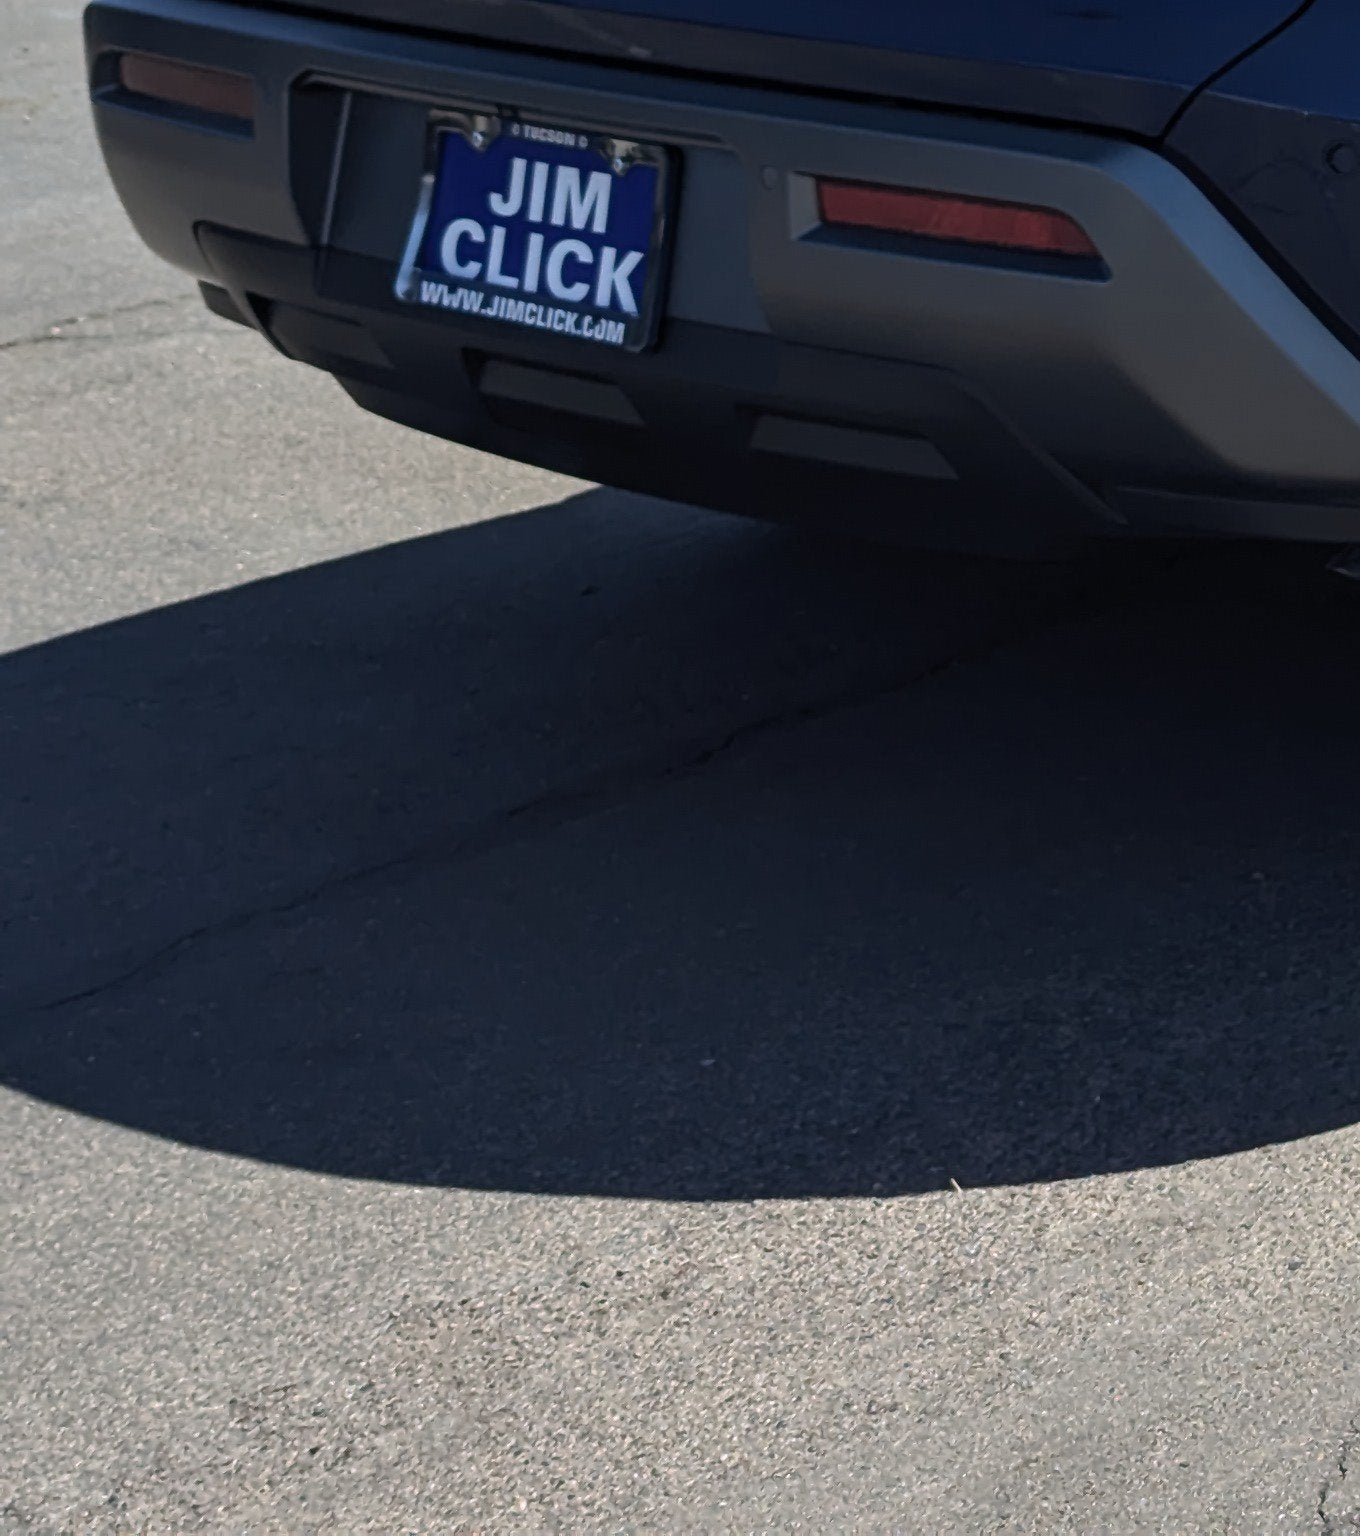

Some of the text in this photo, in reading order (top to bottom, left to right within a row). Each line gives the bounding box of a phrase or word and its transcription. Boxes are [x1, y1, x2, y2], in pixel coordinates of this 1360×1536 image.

[488, 156, 612, 233] JIM
[440, 217, 645, 318] CLICK
[420, 280, 627, 345] WWW.JIMCLICK.COM
